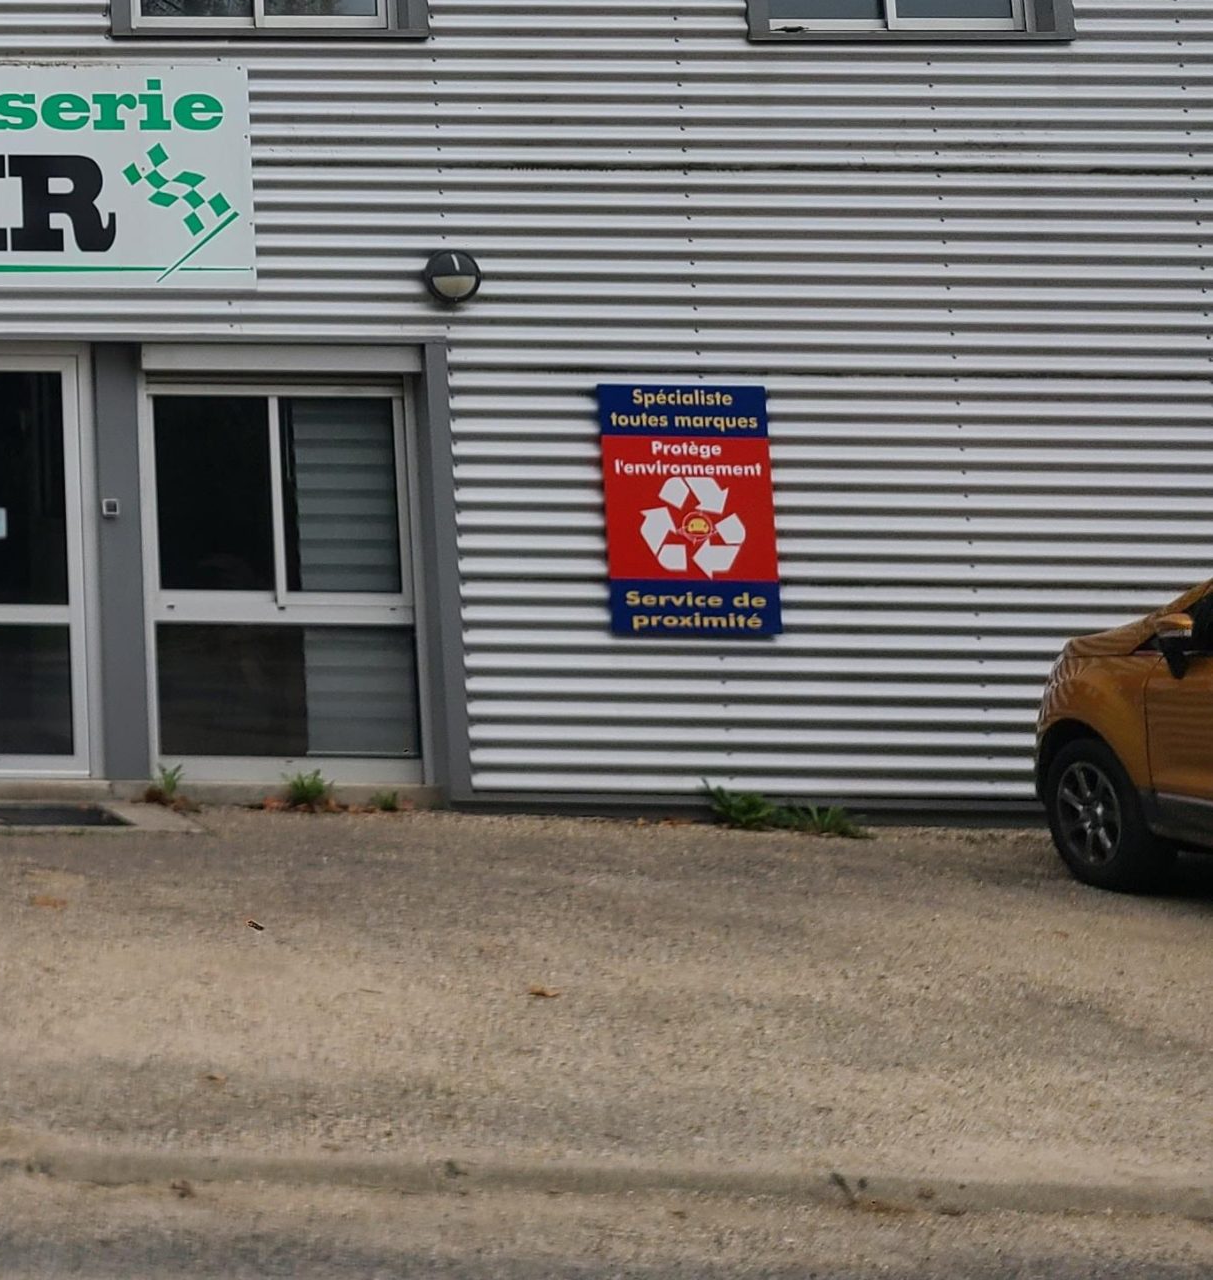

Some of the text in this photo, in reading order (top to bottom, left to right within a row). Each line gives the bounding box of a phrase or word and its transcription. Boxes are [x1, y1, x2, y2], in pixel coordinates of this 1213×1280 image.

[632, 388, 733, 409] Spécialiste
[610, 412, 759, 432] toutes marques
[651, 440, 723, 459] Protège
[614, 458, 763, 477] l'environnement
[625, 590, 767, 608] Service de
[632, 612, 764, 631] proximité
